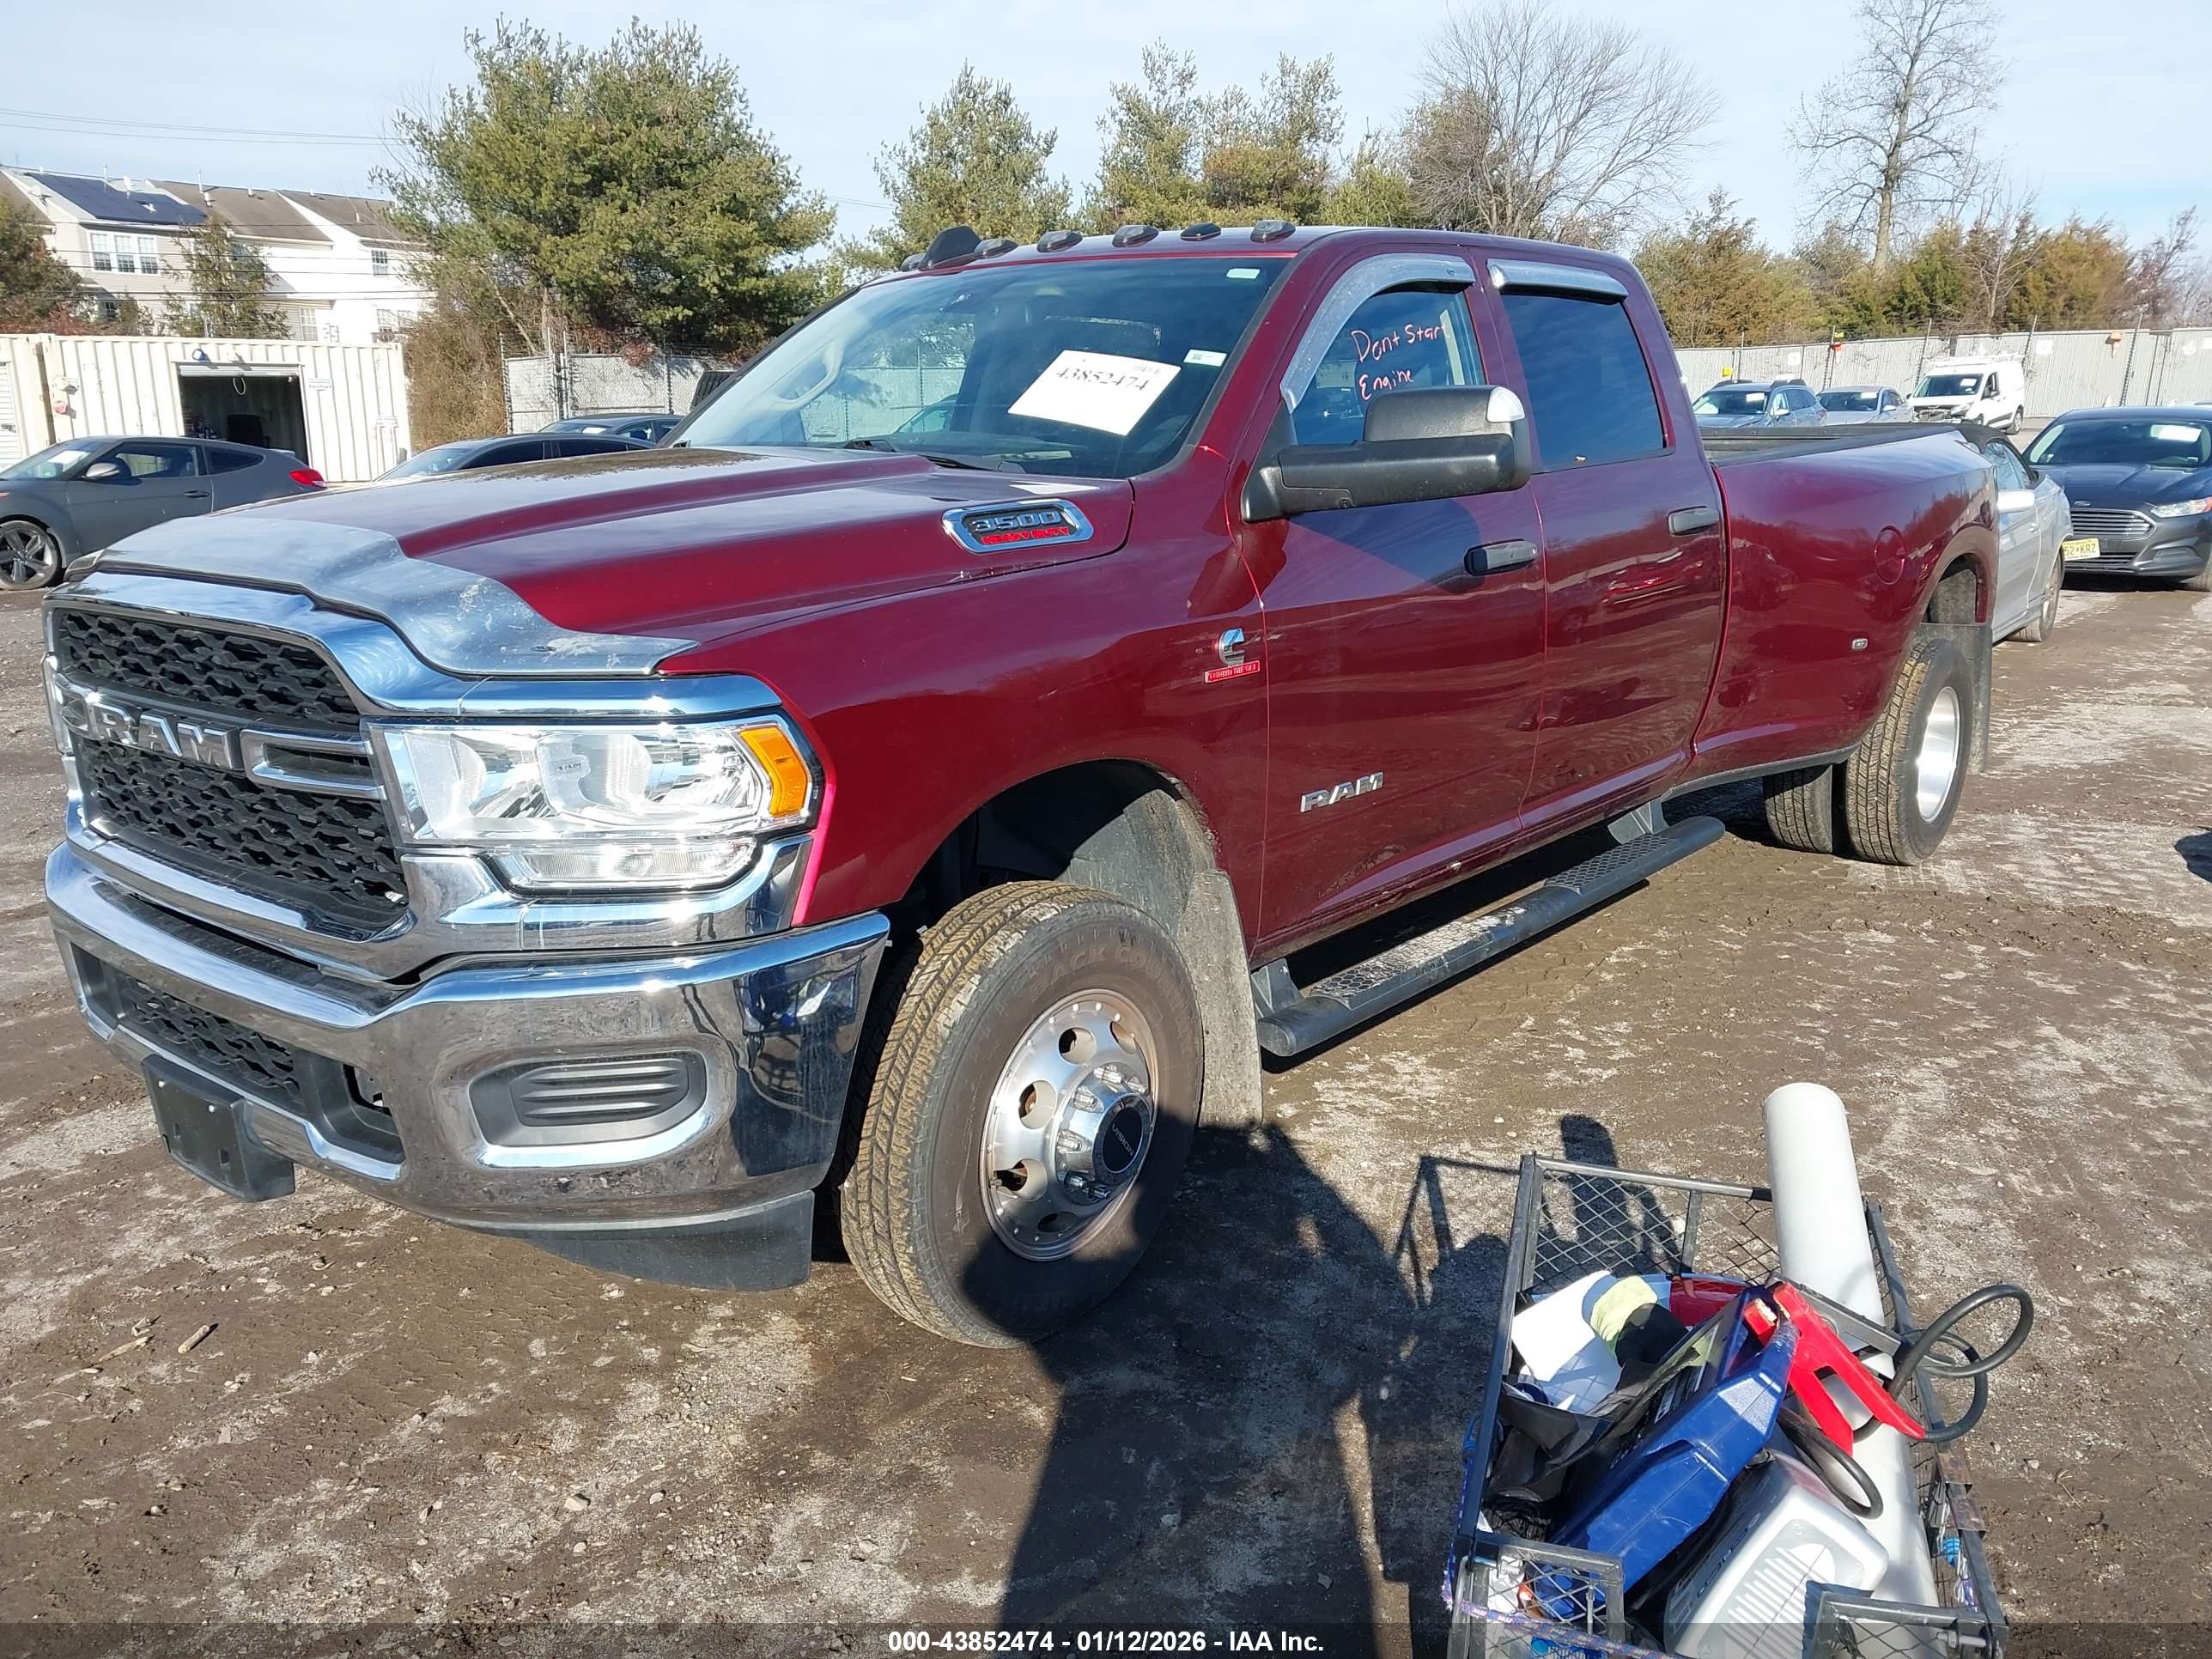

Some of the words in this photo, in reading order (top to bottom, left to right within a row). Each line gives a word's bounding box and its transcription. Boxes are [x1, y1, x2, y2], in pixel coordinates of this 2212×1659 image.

[1351, 330, 1400, 362] Dont
[1404, 323, 1451, 344] Start
[1056, 366, 1151, 392] 43852474
[1358, 369, 1414, 400] Engine
[971, 510, 1062, 533] 3500
[87, 697, 246, 770] RAM
[1299, 771, 1384, 813] RAM
[1111, 1122, 1134, 1157] VISION
